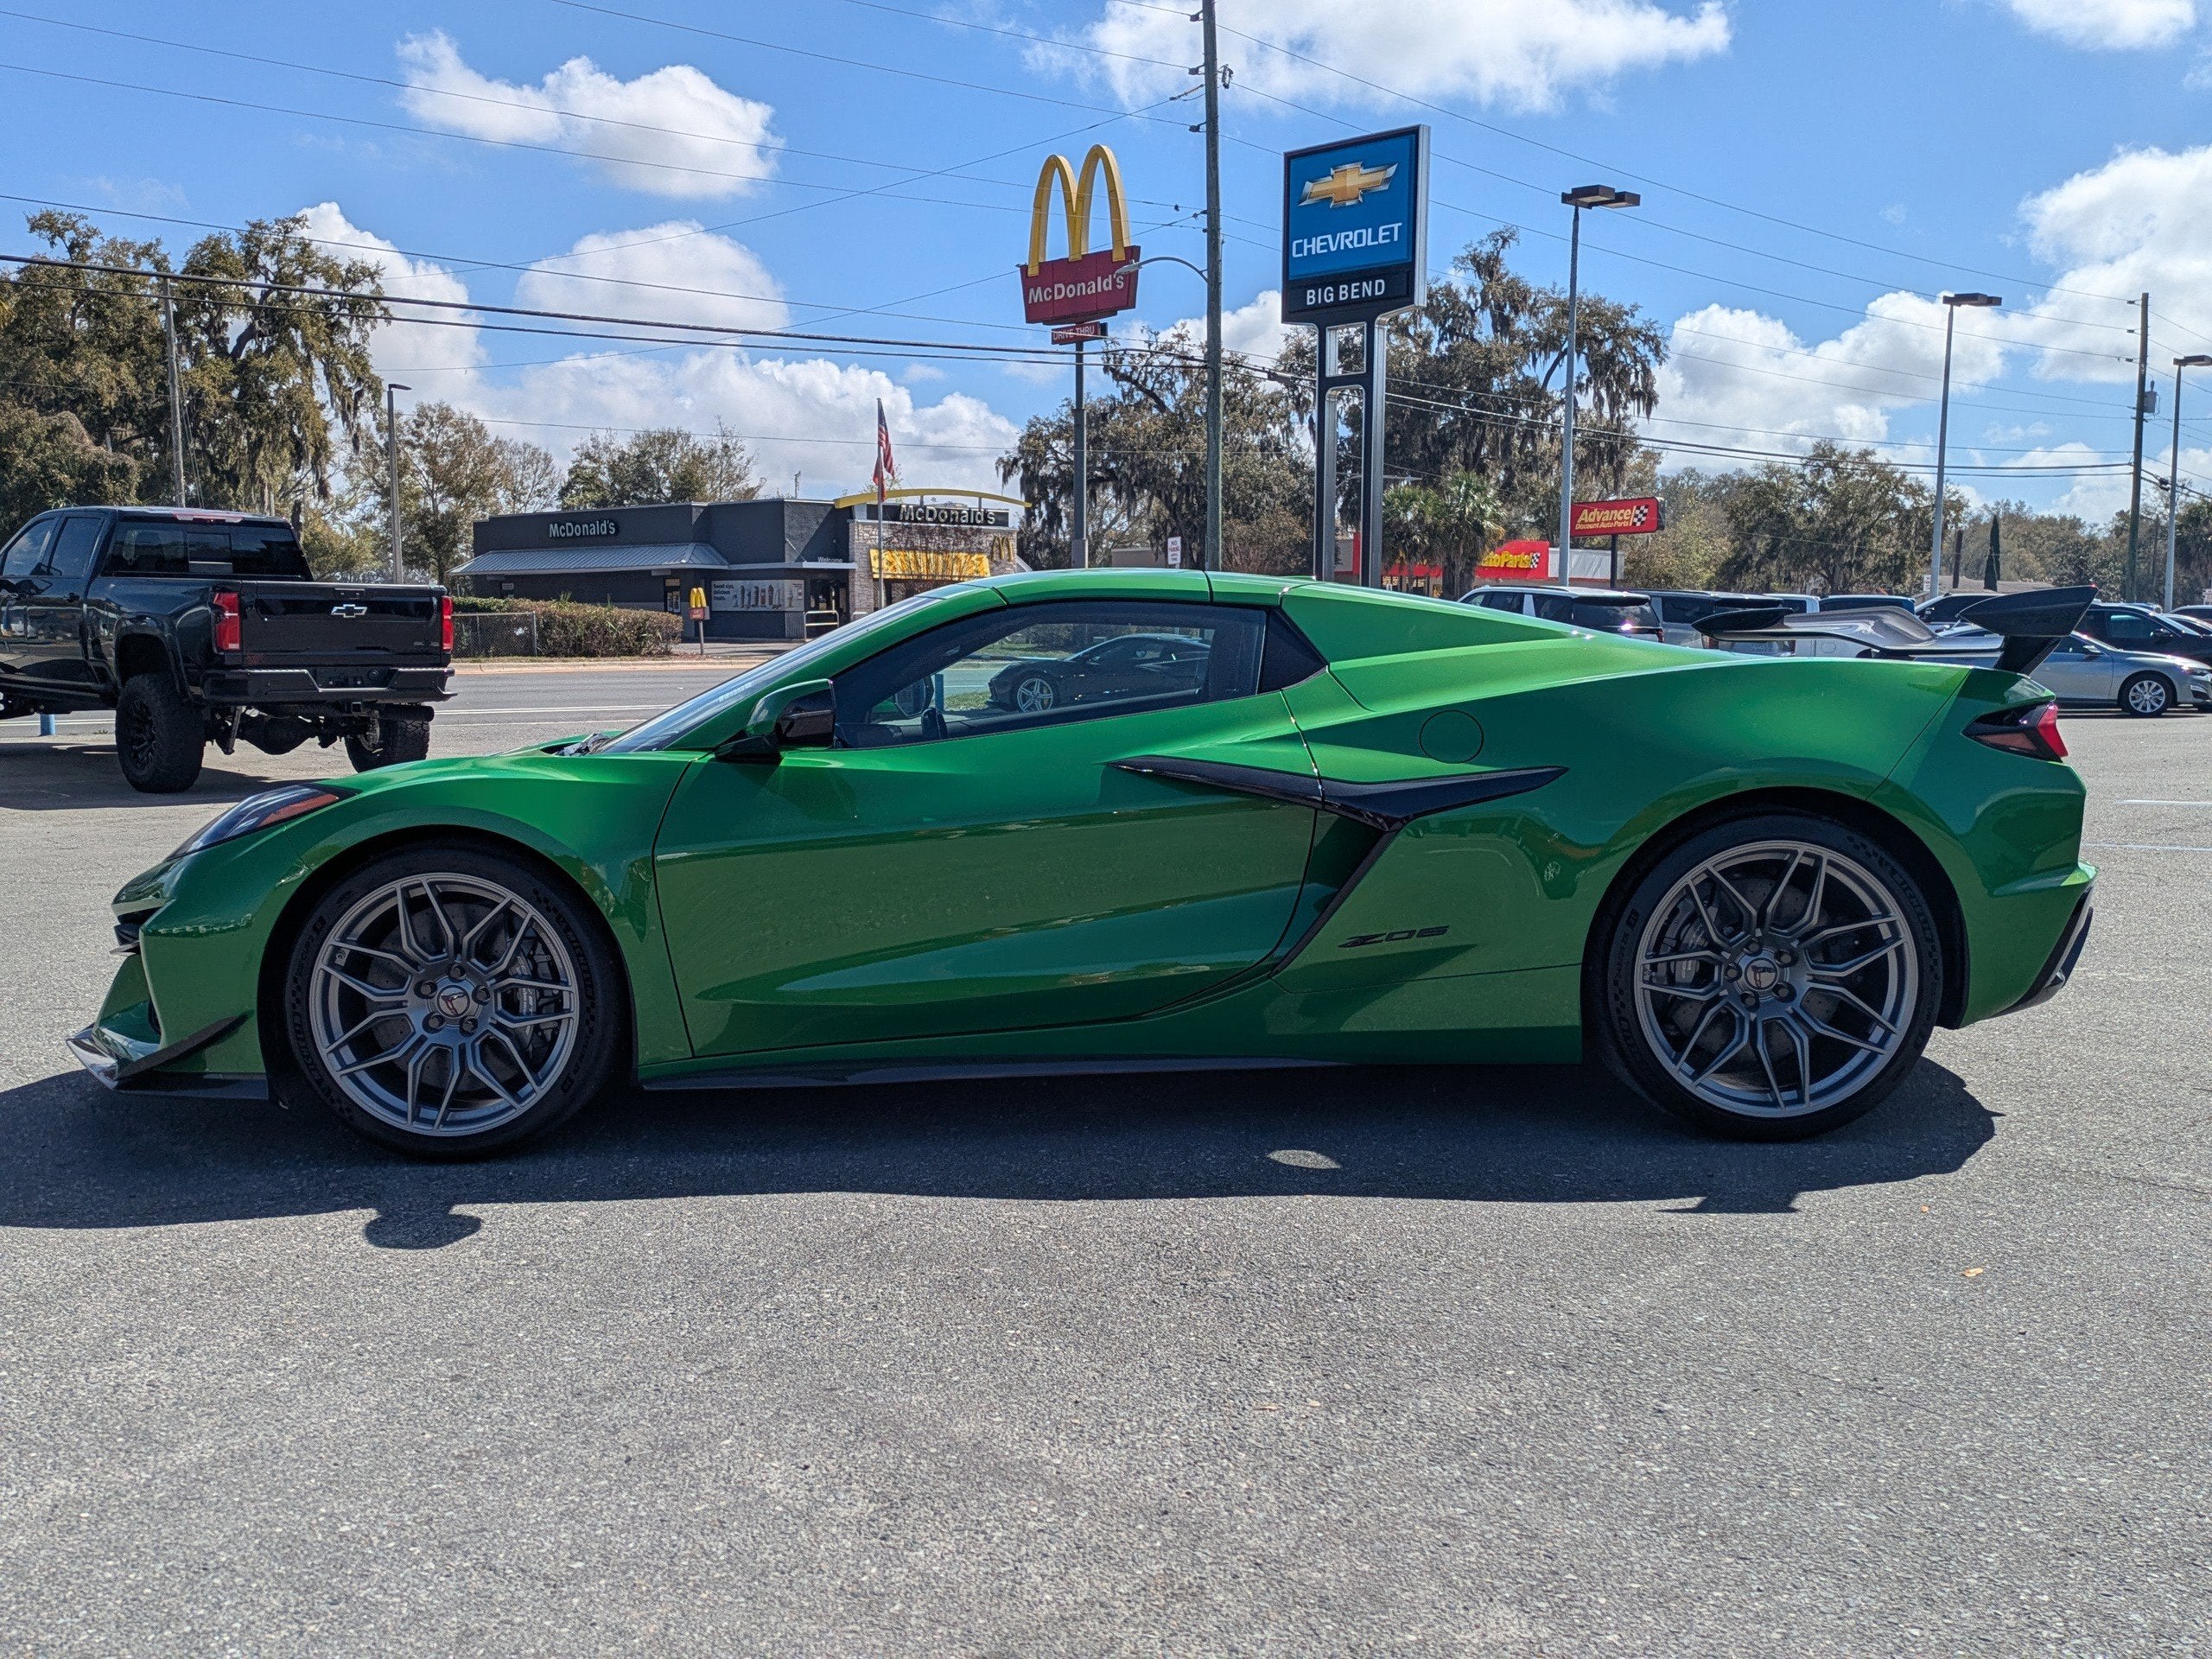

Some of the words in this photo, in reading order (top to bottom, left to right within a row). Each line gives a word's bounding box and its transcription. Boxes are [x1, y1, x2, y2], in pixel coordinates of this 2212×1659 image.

[1292, 222, 1402, 258] CHEVROLET
[1028, 274, 1125, 304] McDonald's
[1306, 286, 1334, 306] BIG
[1338, 279, 1386, 302] BEND
[1053, 328, 1074, 340] DRIVE
[1075, 325, 1096, 337] THRU
[899, 504, 995, 525] McDonald's
[1577, 507, 1632, 524] Advance
[1614, 519, 1630, 528] Parts
[549, 519, 616, 537] McDonald's
[1338, 925, 1450, 949] Z06
